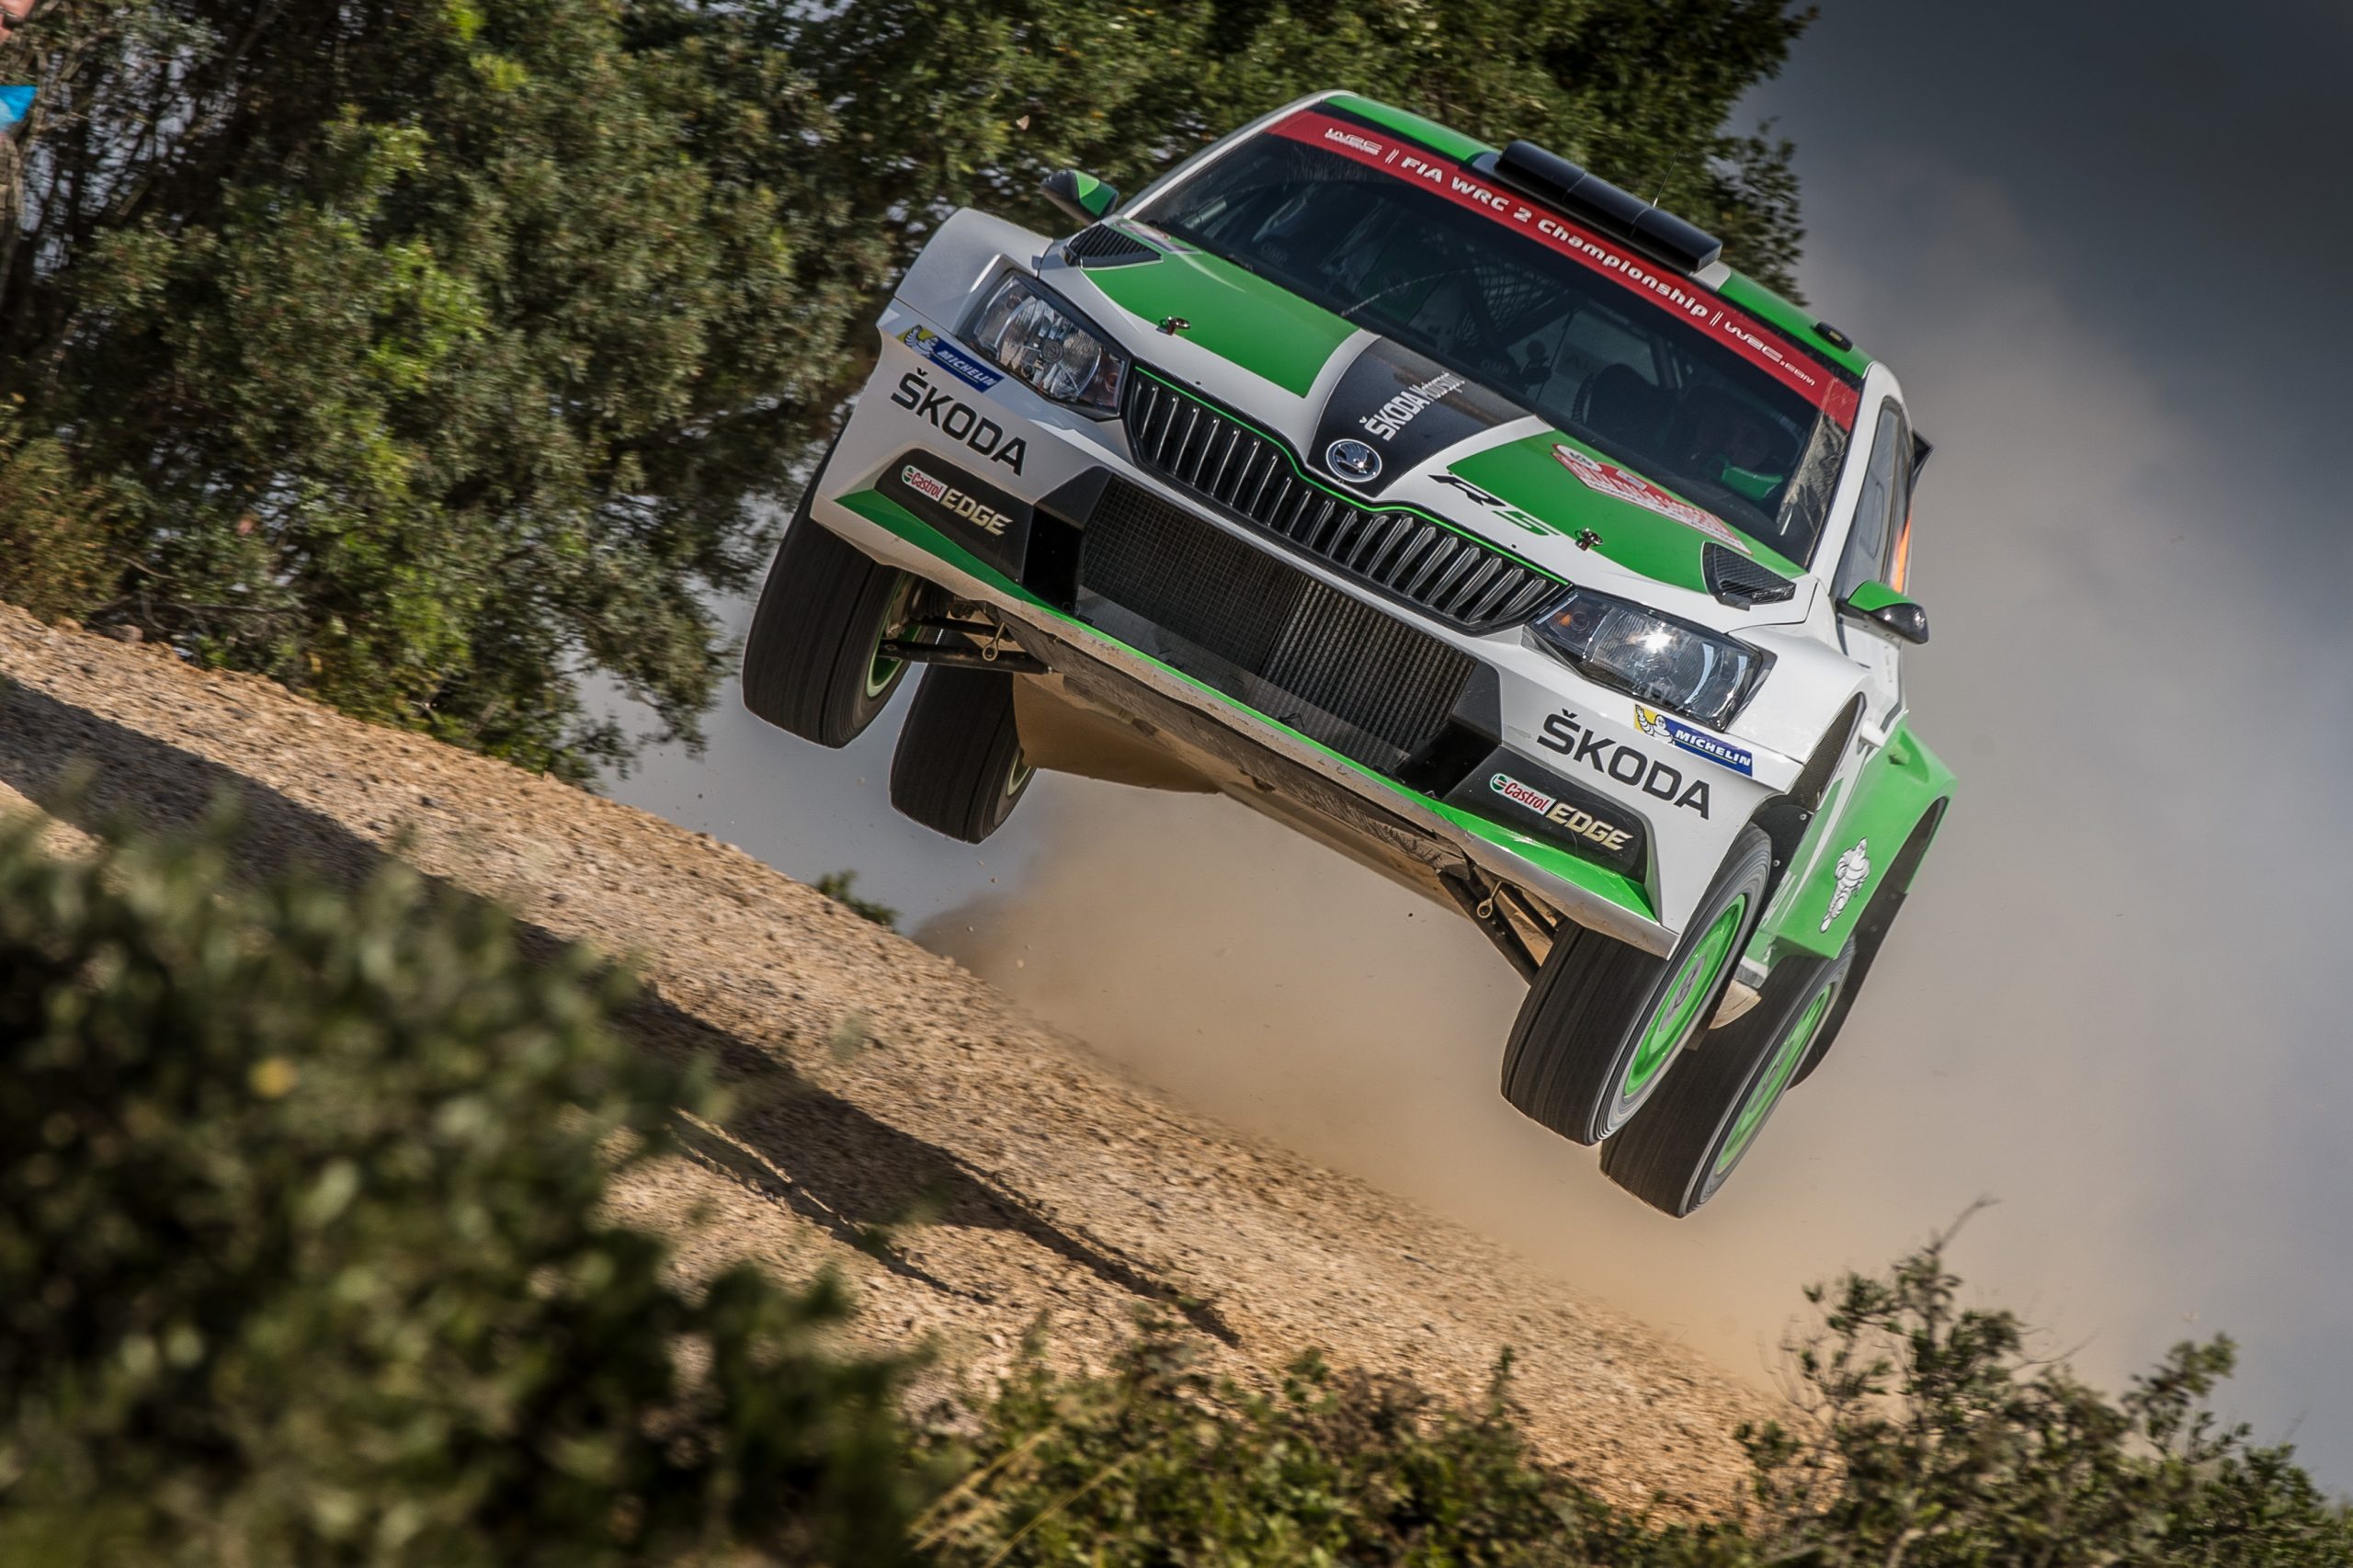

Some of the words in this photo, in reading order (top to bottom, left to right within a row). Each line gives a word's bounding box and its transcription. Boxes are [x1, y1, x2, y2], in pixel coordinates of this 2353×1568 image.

[1401, 156, 1443, 183] FIA
[1451, 176, 1510, 212] WRC
[1513, 206, 1533, 223] 2
[1537, 219, 1709, 319] Championship
[937, 349, 997, 387] MICHELIN
[890, 367, 1028, 477] ŠKODA
[1358, 391, 1431, 441] ŠKODA
[911, 472, 944, 499] Castrol
[939, 488, 1014, 537] EDGE
[1537, 709, 1711, 821] ŠKODA
[1674, 728, 1753, 768] MICHELIN
[1504, 781, 1552, 812] Castrol
[1546, 802, 1634, 851] EDGE
